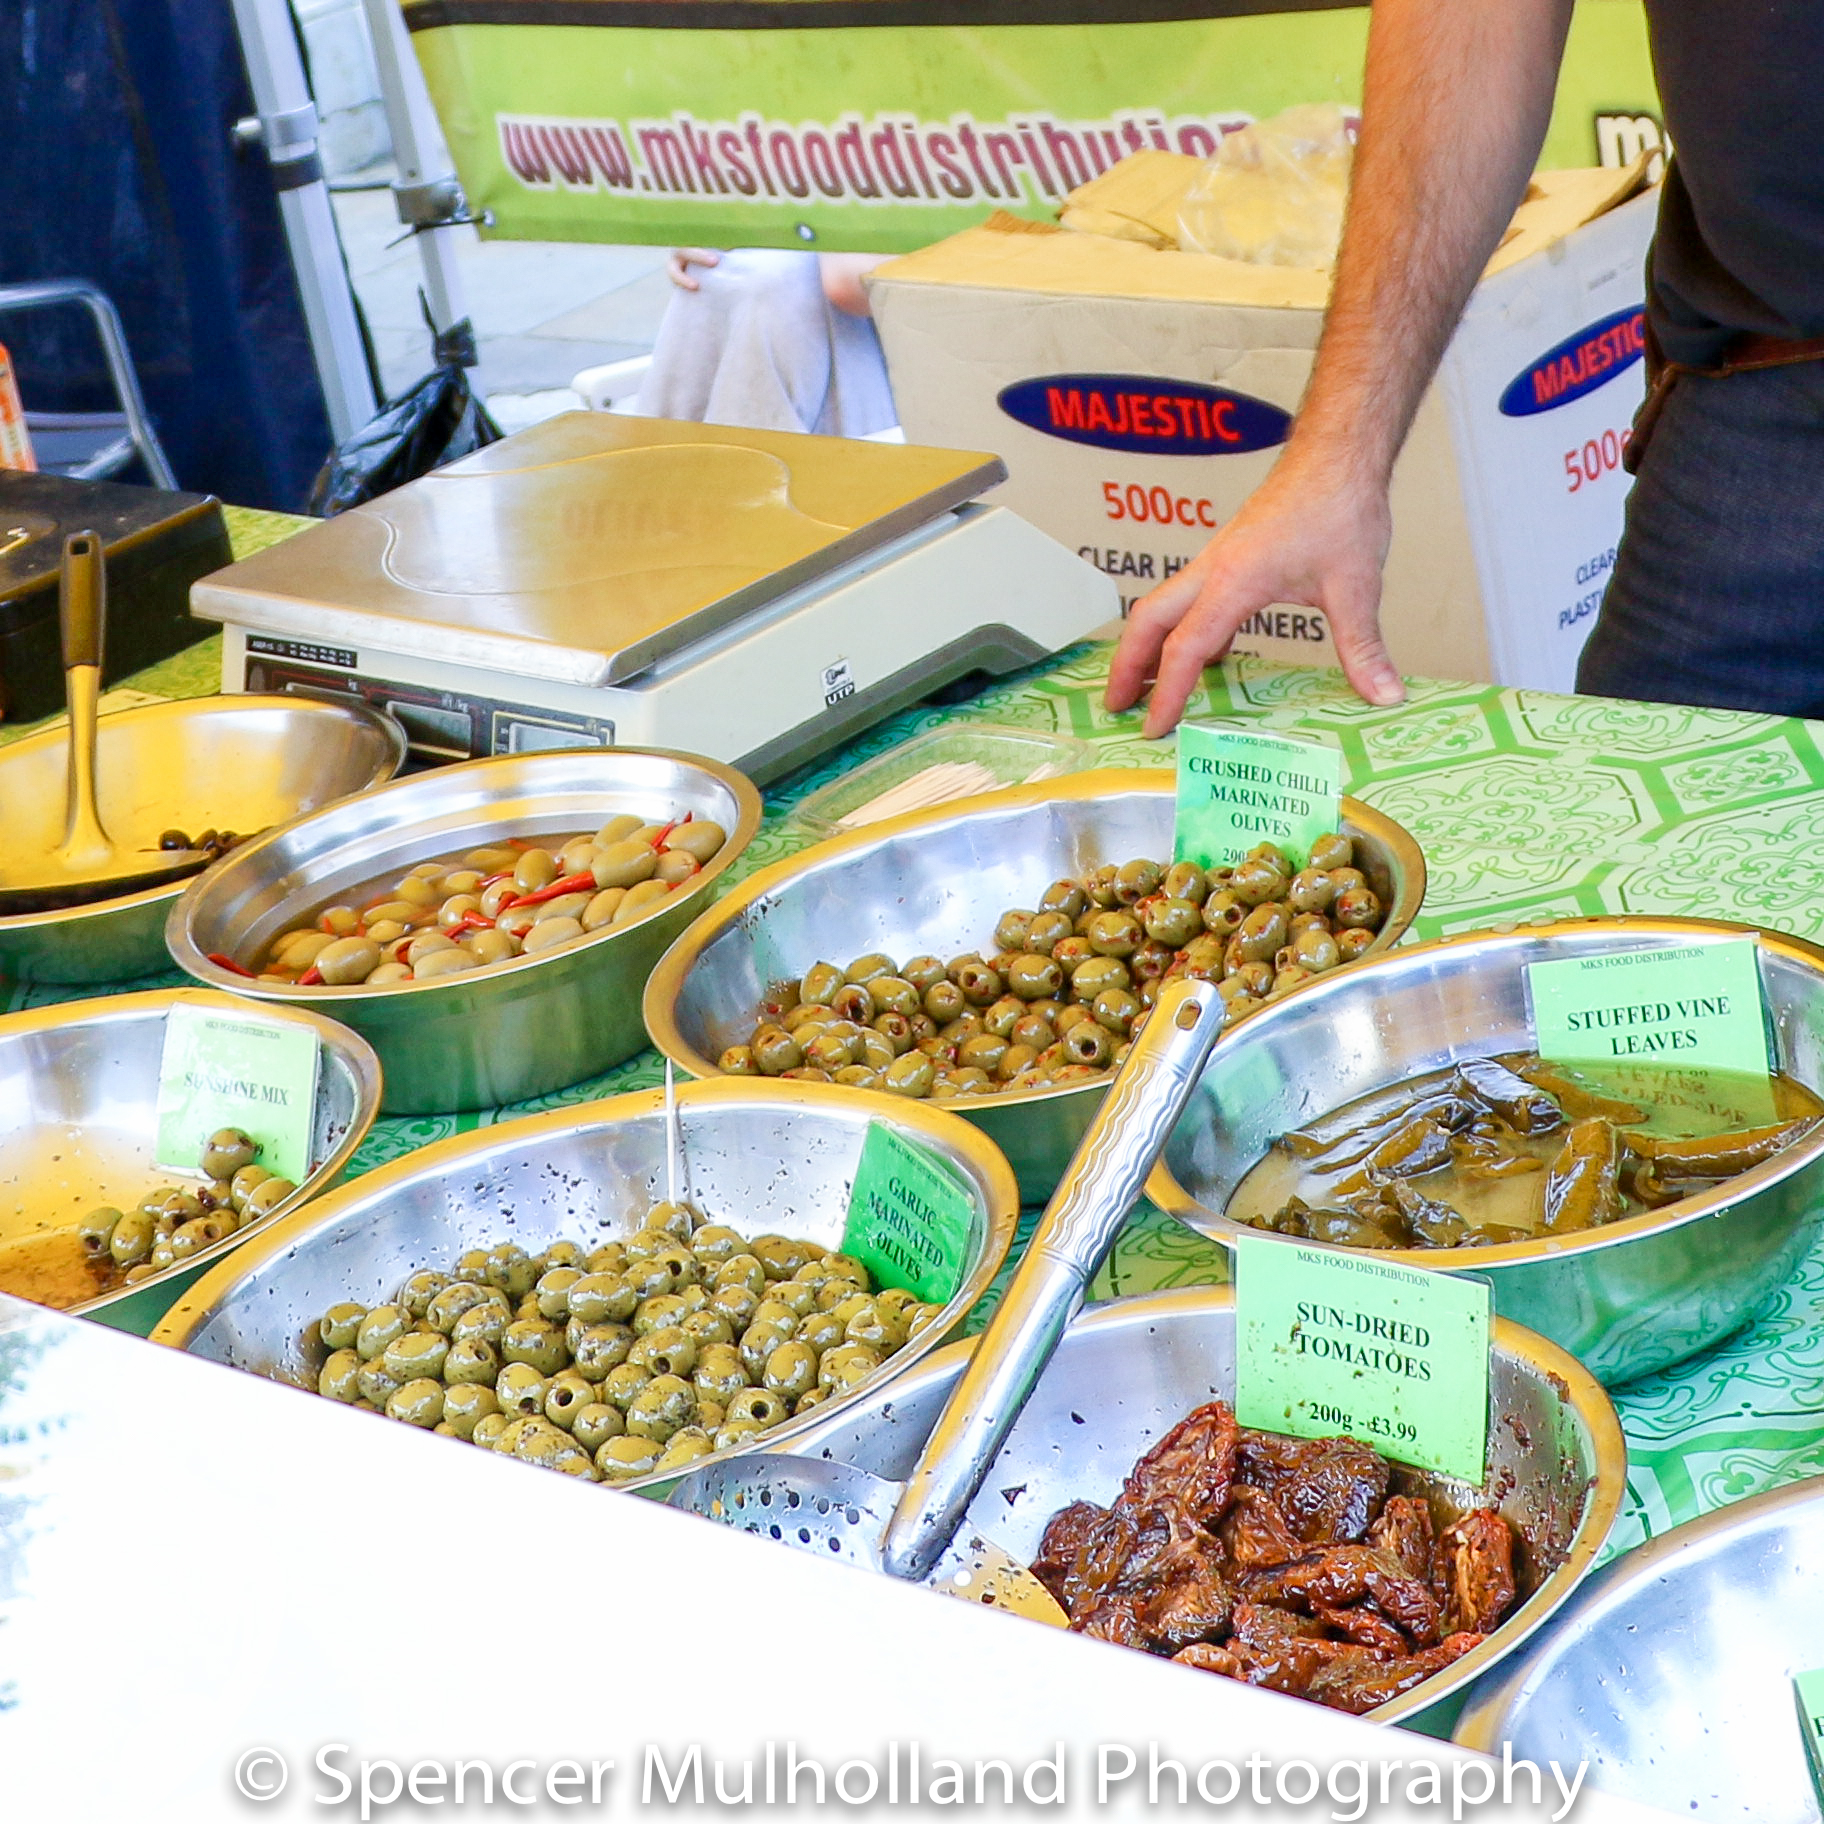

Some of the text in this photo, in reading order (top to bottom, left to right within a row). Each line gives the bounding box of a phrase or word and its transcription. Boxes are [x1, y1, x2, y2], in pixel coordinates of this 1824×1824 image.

[1532, 312, 1647, 404] MAJESTIC
[1046, 387, 1241, 441] MAJESTIC
[1102, 481, 1216, 527] 500cc
[1077, 545, 1155, 579] CLEAR
[827, 684, 854, 705] UTP
[1188, 756, 1329, 796] CRUSHED CHILLI
[1210, 784, 1310, 817] MARINATED
[1231, 811, 1292, 838] OLIVES
[1223, 848, 1249, 863] 200
[1580, 947, 1705, 971] MKS FOOD DISTRIBUTION
[1567, 996, 1732, 1032] STUFFED VINE
[1610, 1029, 1699, 1056] LEAVES
[184, 1071, 290, 1106] SUNSHINE MIX
[888, 1176, 937, 1231] GARLIC
[867, 1190, 944, 1269] MARINATED
[875, 1230, 922, 1283] OLIVES
[1296, 1250, 1431, 1288] MKS FOOD DISTRIBUTION
[1296, 1300, 1431, 1348] SUN-DRIED
[1295, 1332, 1432, 1382] TOMATOES
[1309, 1402, 1353, 1431] 200g
